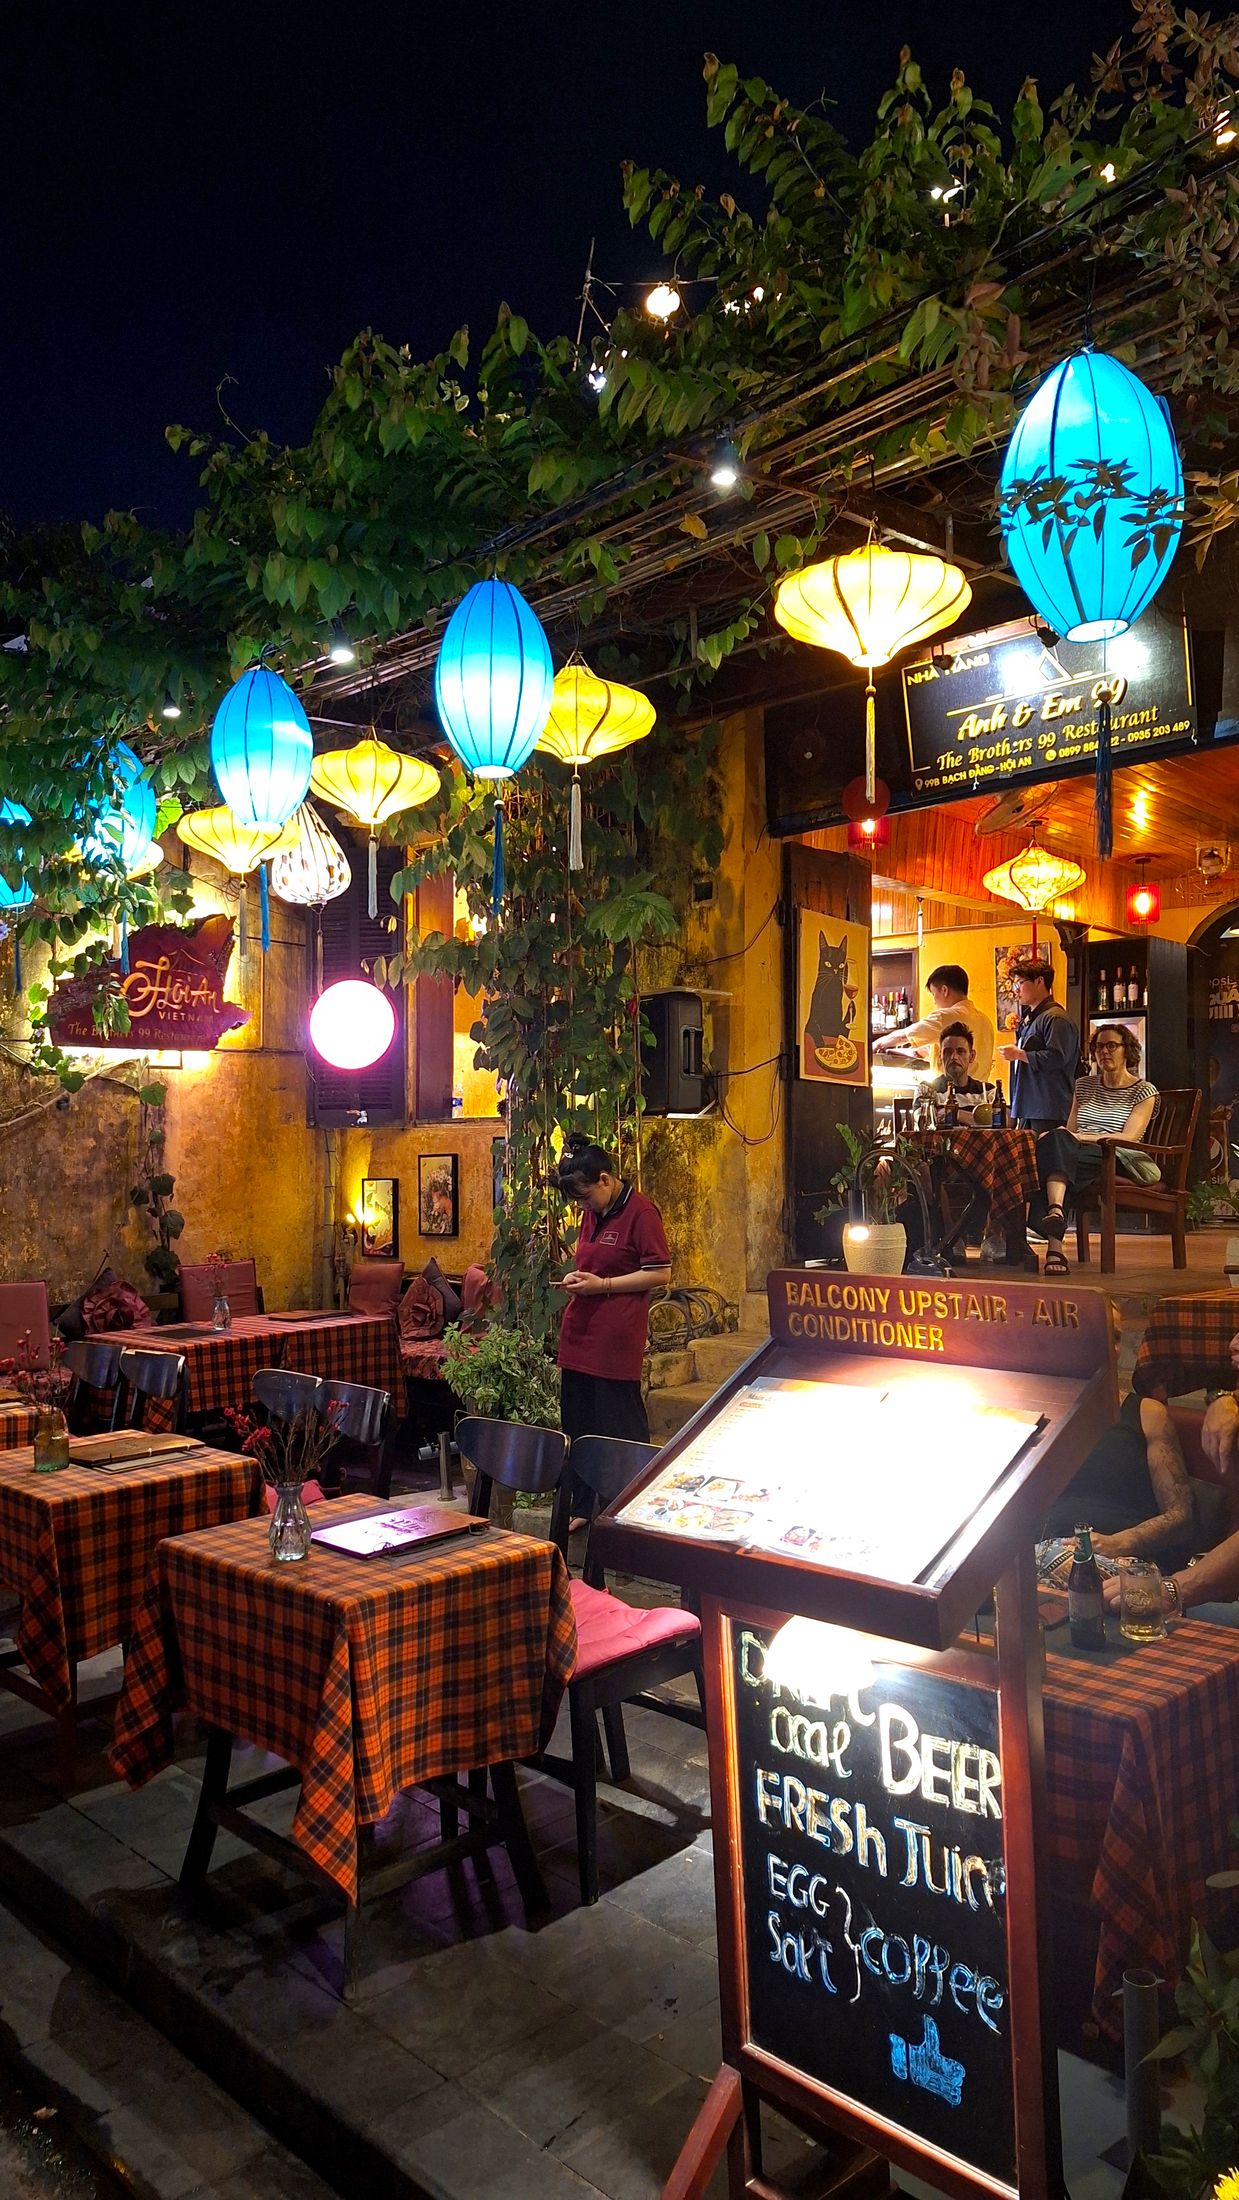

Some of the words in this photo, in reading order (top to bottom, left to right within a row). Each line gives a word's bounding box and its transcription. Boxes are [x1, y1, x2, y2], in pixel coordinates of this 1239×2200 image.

[943, 653, 990, 676] ÀNG
[957, 702, 1008, 741] Anh
[1011, 701, 1035, 727] &
[1040, 691, 1083, 721] Em
[937, 750, 963, 771] The
[1037, 731, 1056, 750] 99
[1062, 705, 1160, 742] Resturant
[1058, 745, 1081, 757] 0899
[1127, 732, 1151, 743] 0935
[1153, 725, 1171, 738] 203
[1172, 720, 1190, 732] 489
[924, 777, 940, 788] 99B
[942, 770, 967, 785] BẠCH
[1017, 755, 1032, 768] AN
[1209, 976, 1230, 989] psi
[67, 1022, 88, 1036] The
[138, 1029, 151, 1039] 99
[785, 1281, 891, 1314] BALCONY
[898, 1289, 1008, 1323] UPSTAIR
[1032, 1298, 1080, 1329] AIR
[788, 1312, 945, 1352] CONDITIONER
[879, 1701, 1002, 1819] BEER
[767, 1852, 831, 1919] EGG
